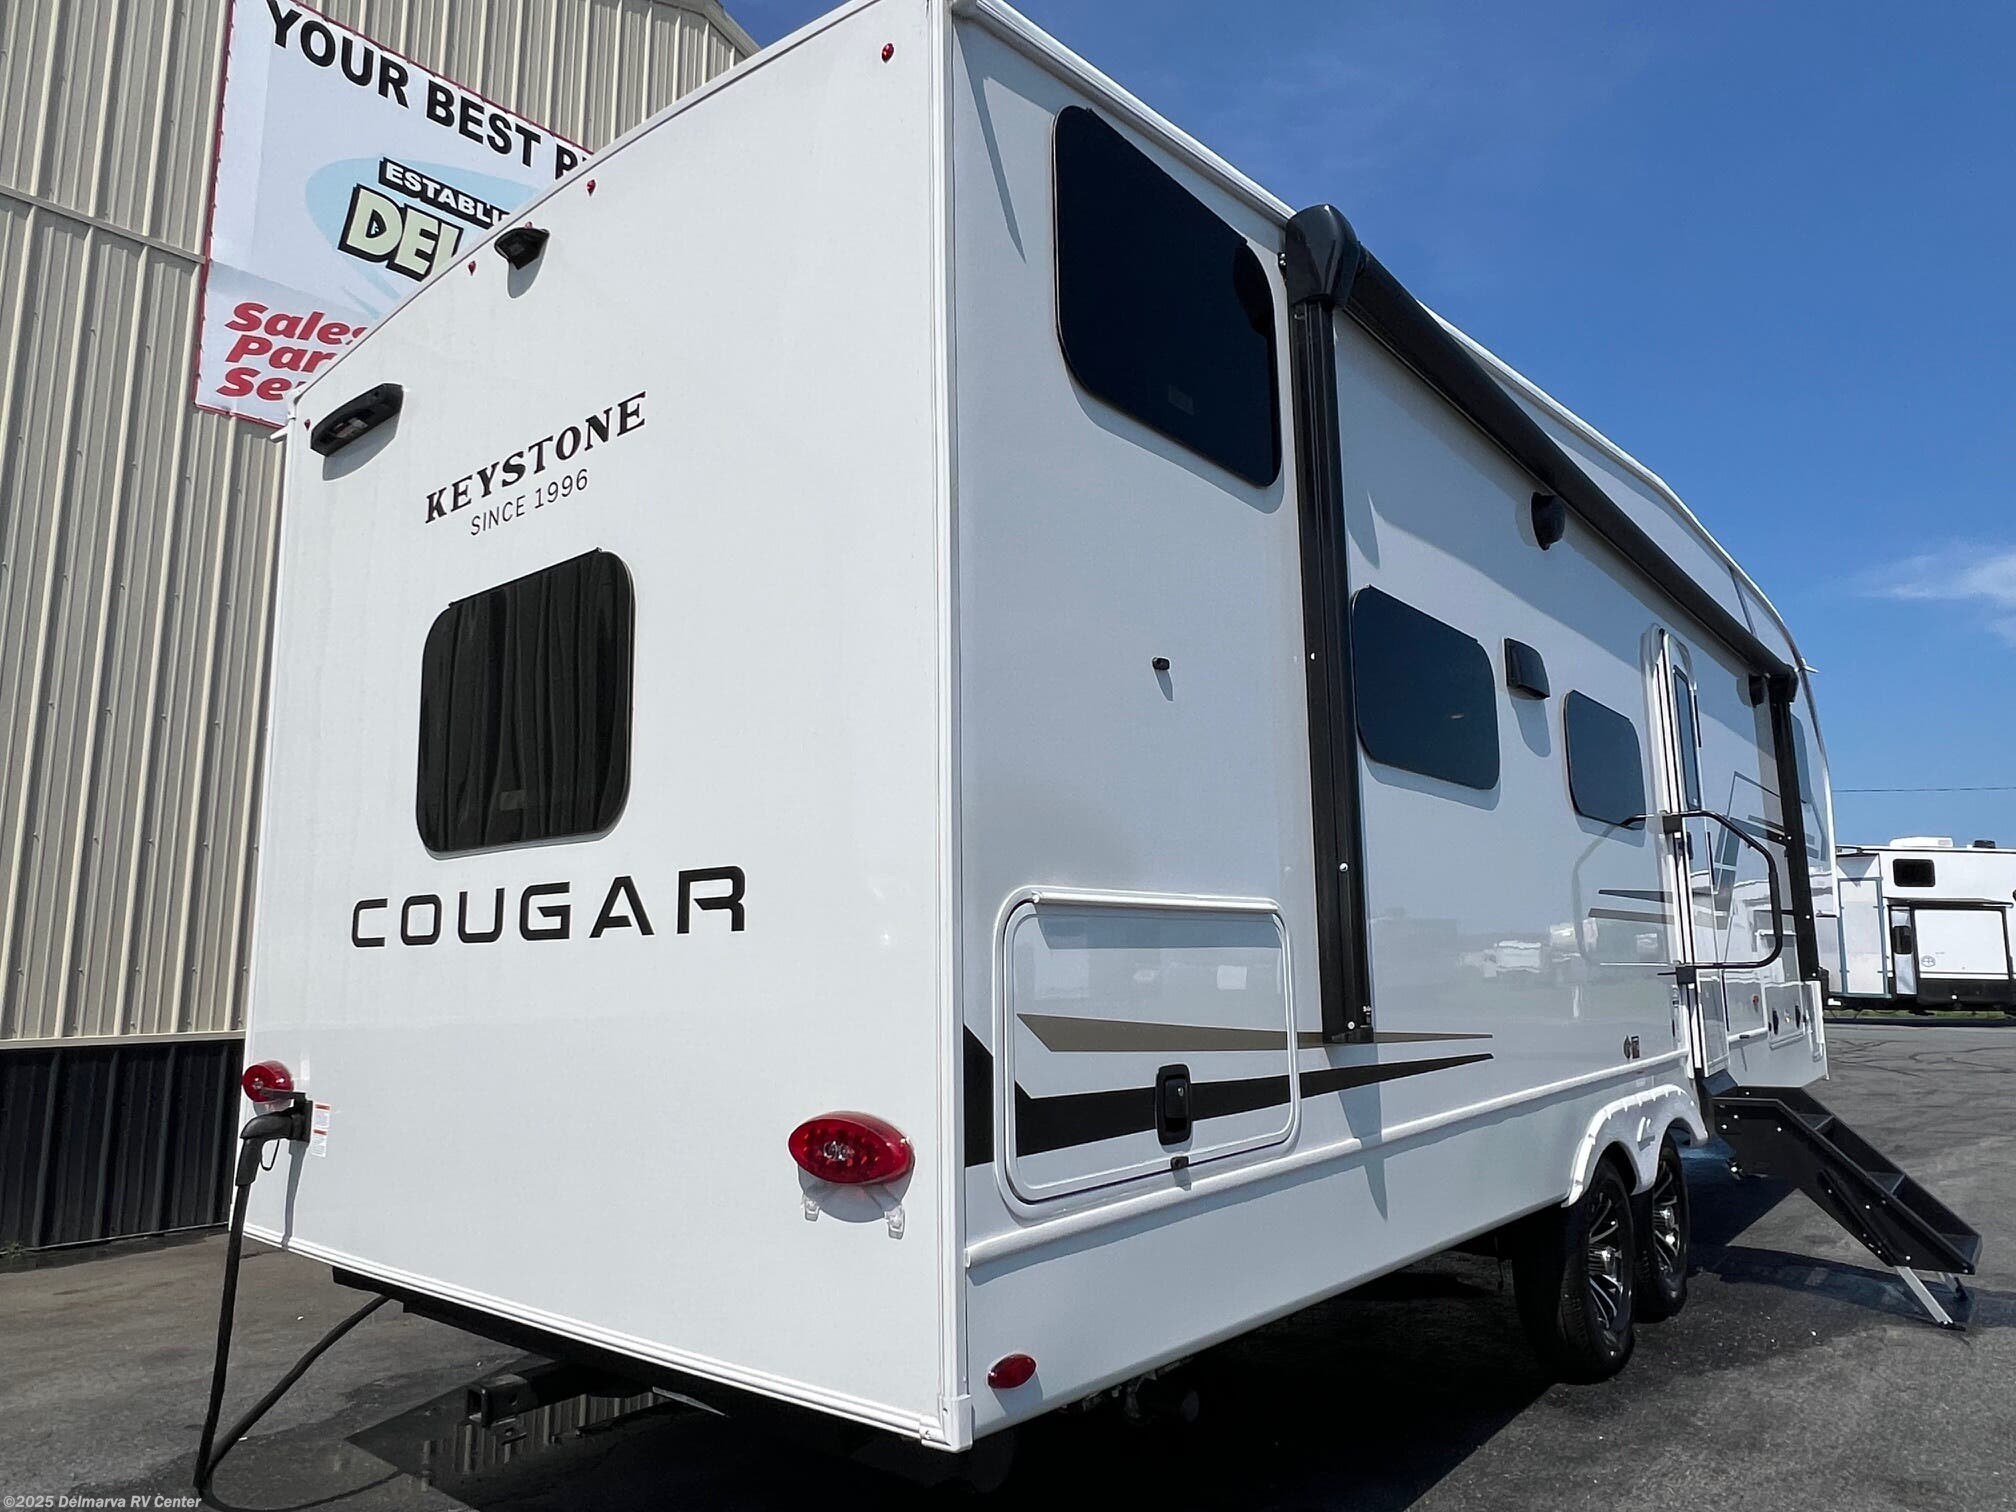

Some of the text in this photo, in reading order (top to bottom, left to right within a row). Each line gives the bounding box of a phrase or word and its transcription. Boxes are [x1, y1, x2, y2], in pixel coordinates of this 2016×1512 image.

[266, 0, 409, 109] YOUR
[426, 79, 541, 168] BEST
[385, 161, 507, 226] ESTABLI
[216, 367, 306, 401] Se
[425, 391, 646, 524] KEYSTONE
[471, 468, 588, 536] SINCE 1996
[351, 866, 745, 948] COUGAR
